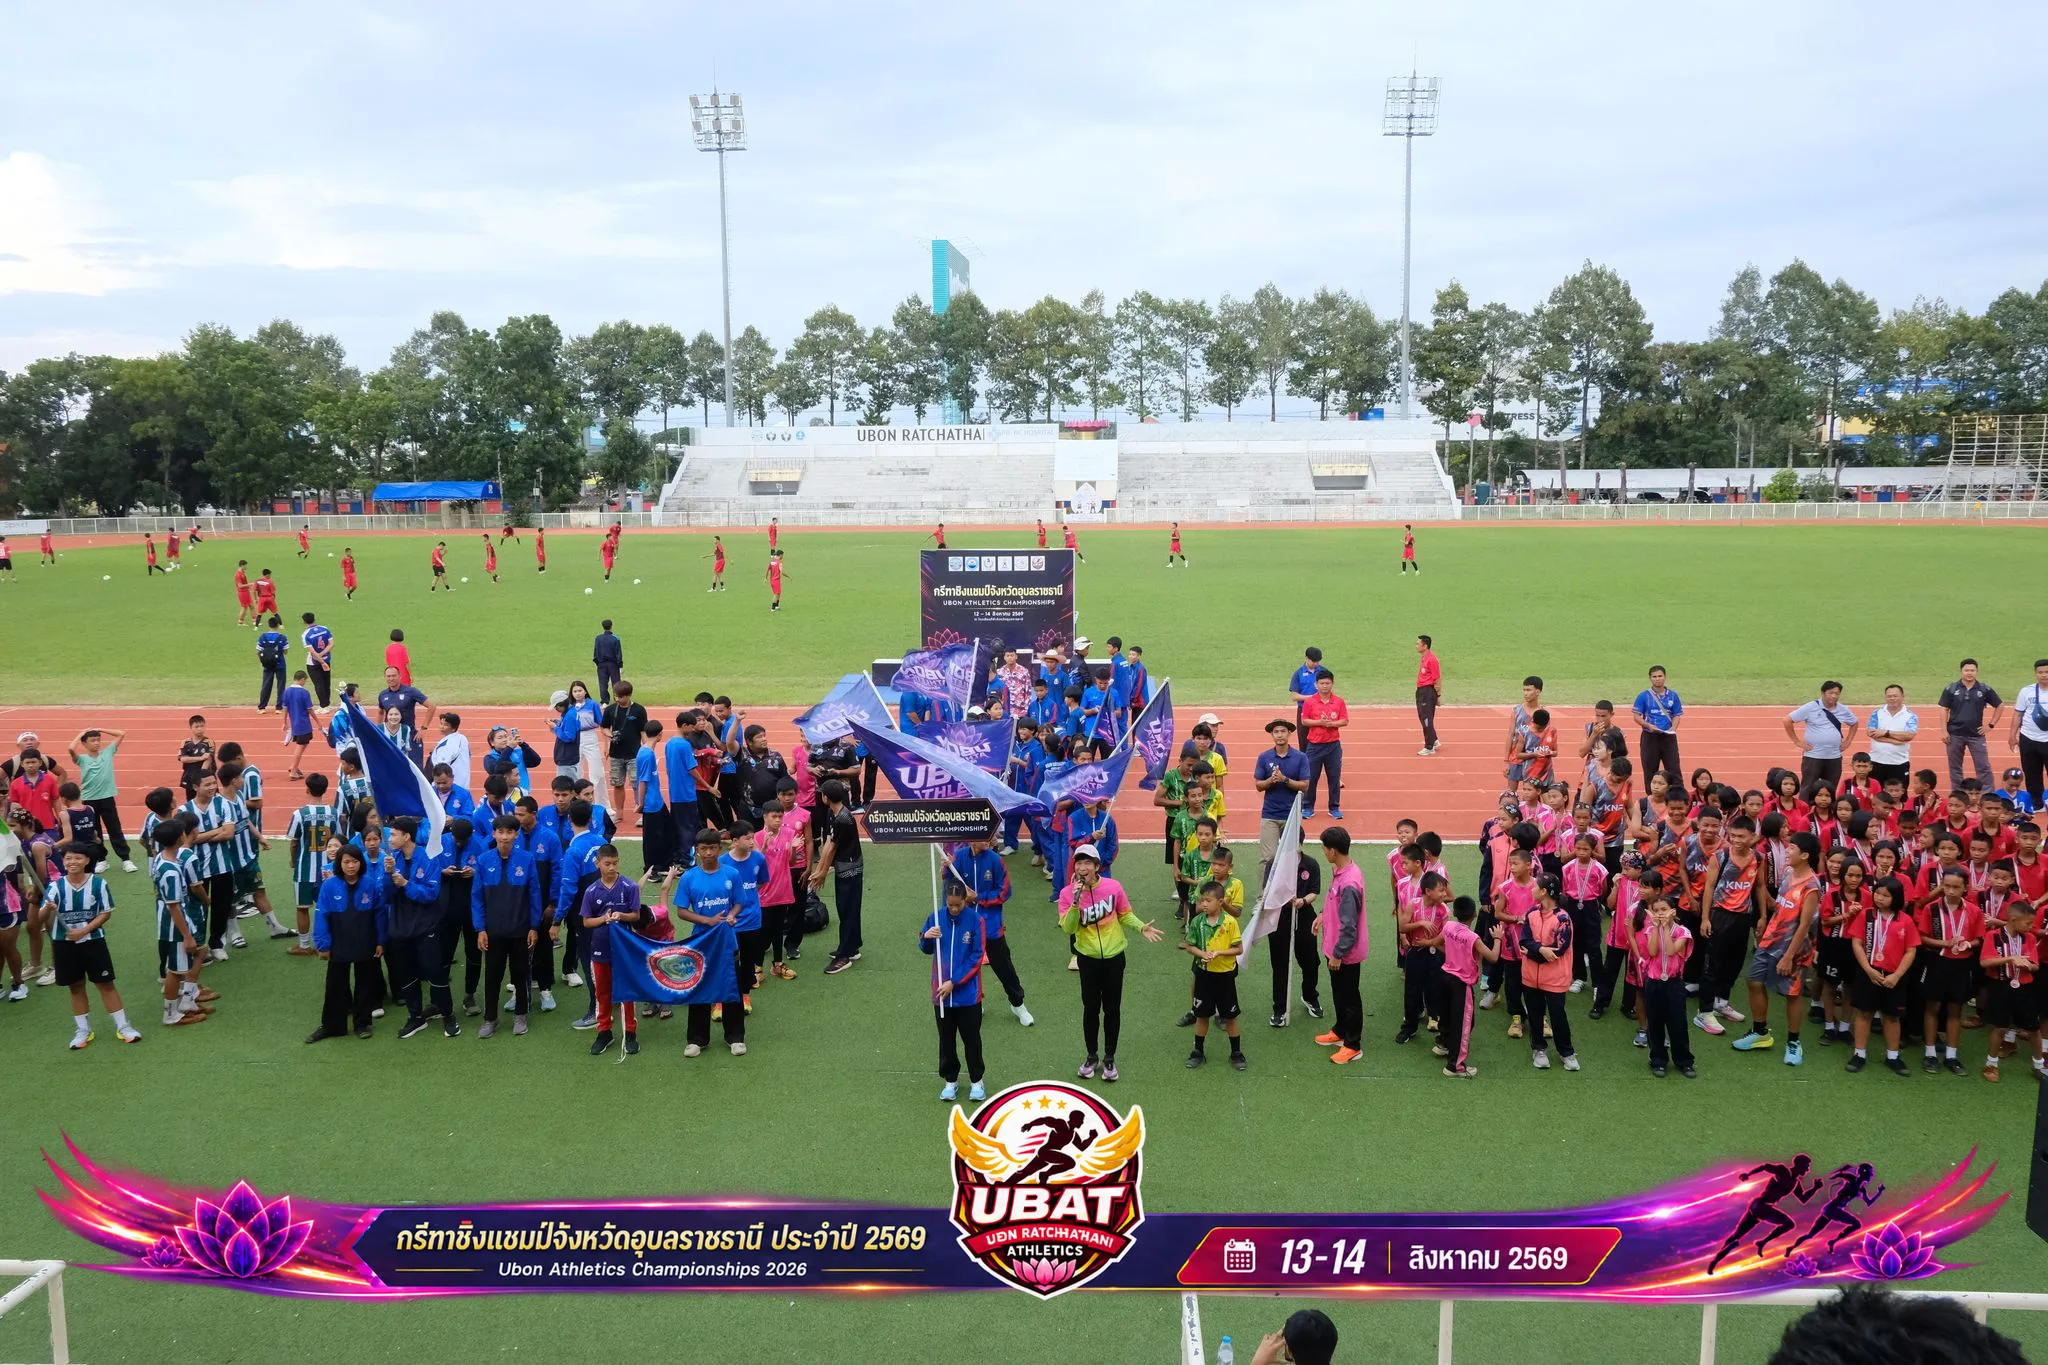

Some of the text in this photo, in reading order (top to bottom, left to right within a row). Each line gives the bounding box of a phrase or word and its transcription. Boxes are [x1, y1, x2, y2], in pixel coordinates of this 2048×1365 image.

[857, 428, 985, 442] UBON RATCHATHA
[317, 635, 326, 649] 4
[309, 825, 331, 852] 13
[1725, 881, 1752, 890] KNP
[1825, 965, 1839, 978] 12
